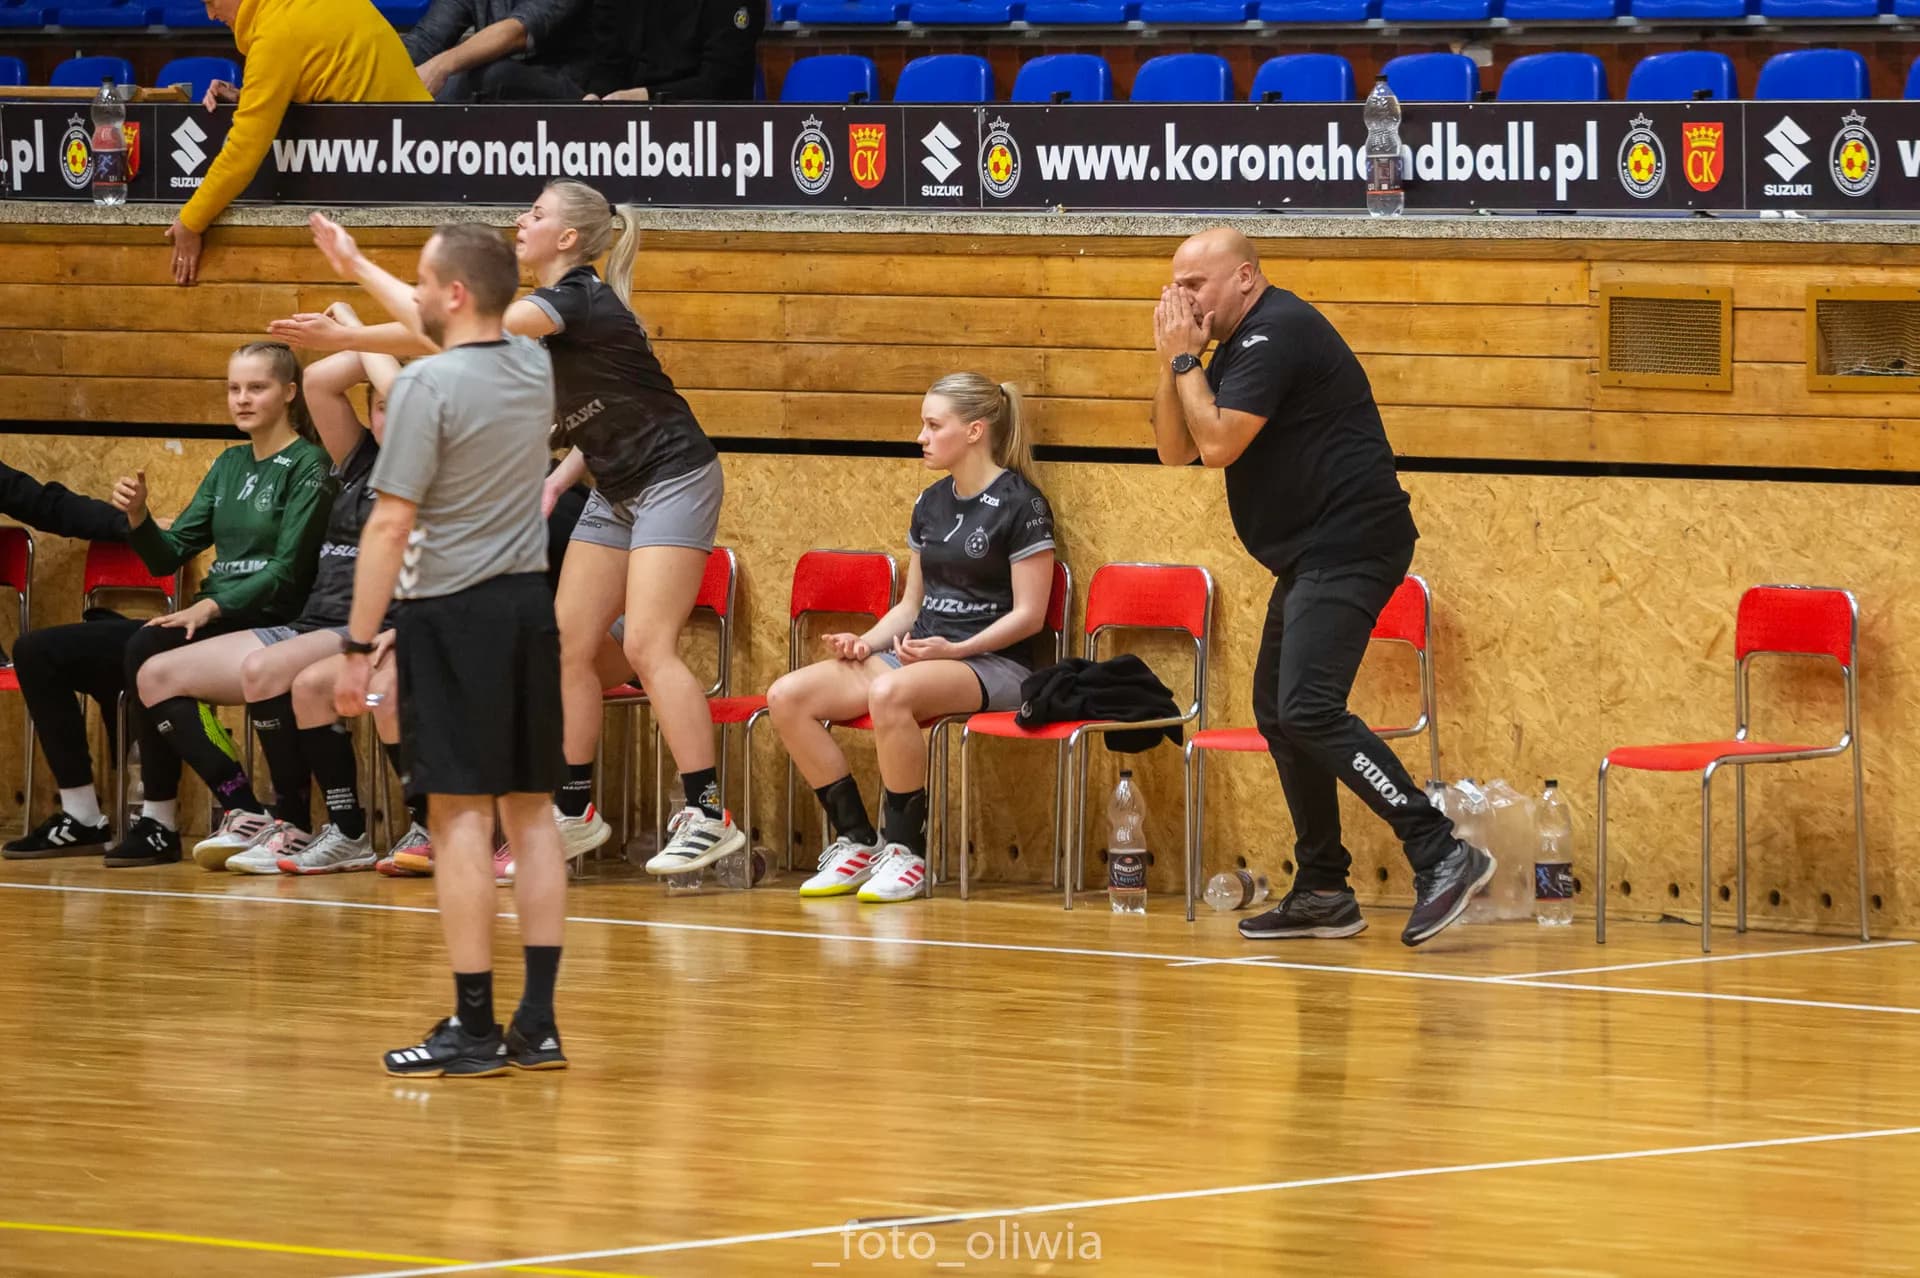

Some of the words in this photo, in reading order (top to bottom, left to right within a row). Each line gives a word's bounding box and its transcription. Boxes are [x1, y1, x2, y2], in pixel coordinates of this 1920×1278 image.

[272, 118, 775, 197] www.koronahandball.pl
[852, 149, 880, 181] CK
[1035, 121, 1599, 201] www.koronahdball.pl
[1687, 149, 1717, 184] CK
[170, 176, 204, 188] SUZUK
[921, 185, 964, 197] SUZUKI
[1763, 183, 1813, 196] SUZUKI
[565, 398, 606, 432] ZUKI
[943, 513, 965, 543] 7
[330, 544, 359, 558] SUZ
[1352, 751, 1408, 807] Joma
